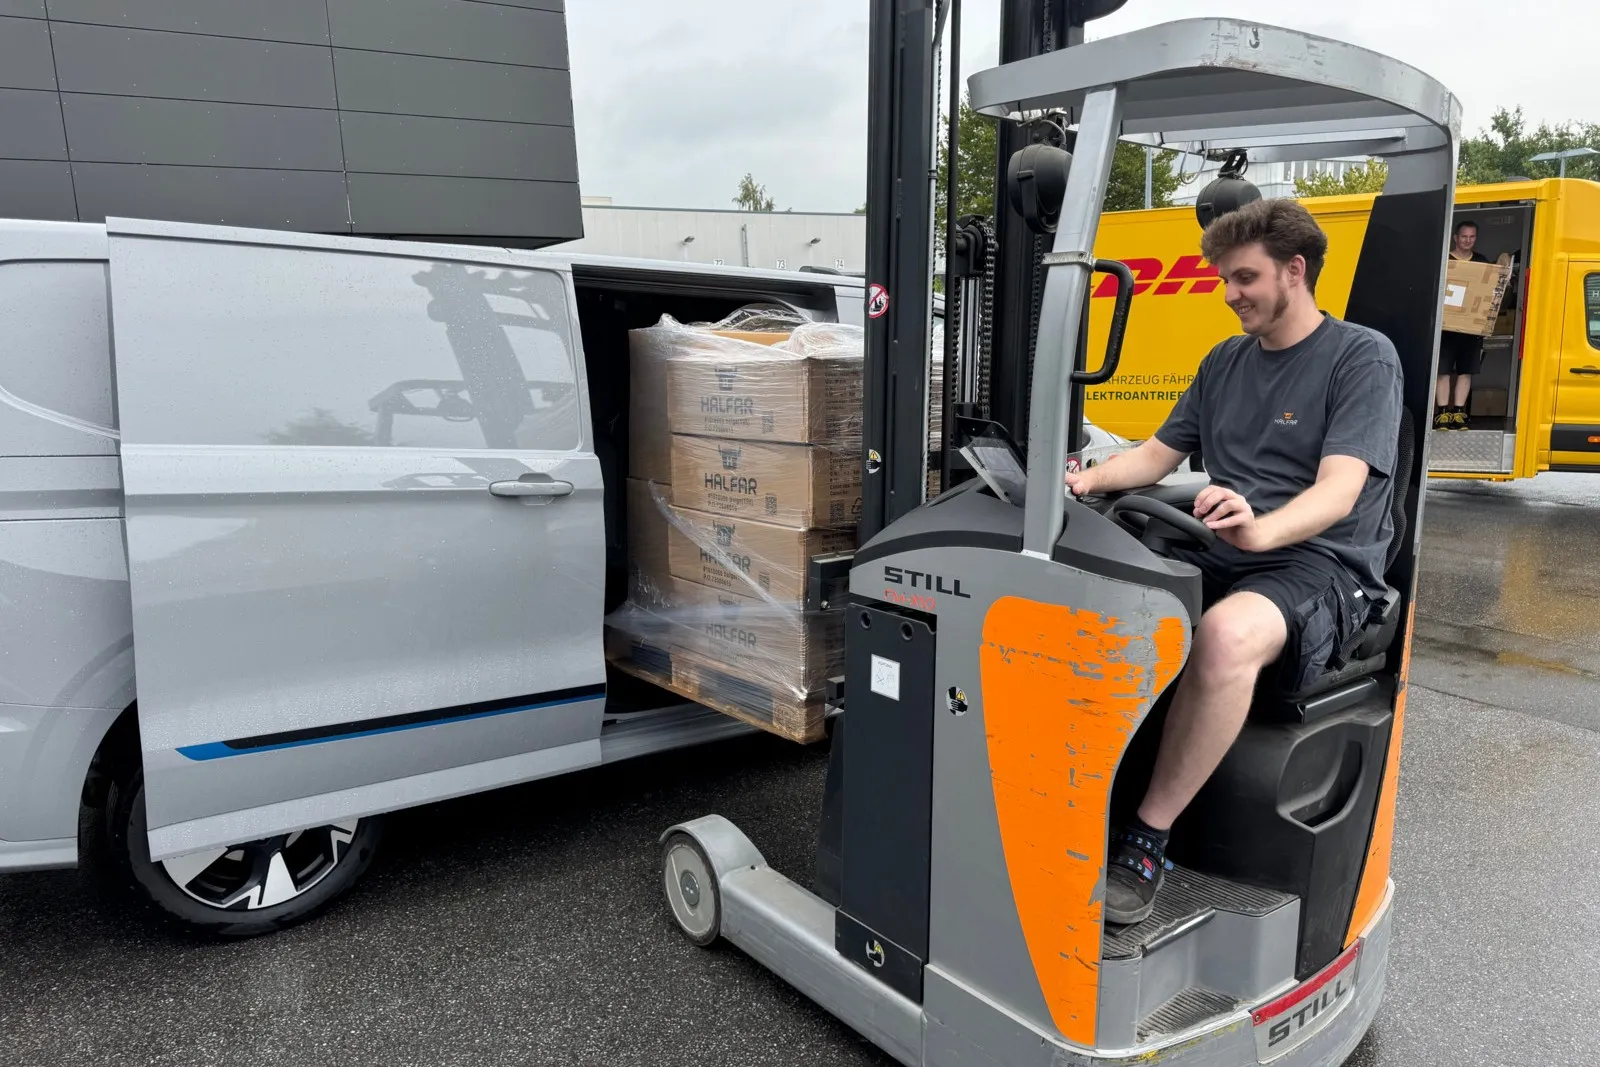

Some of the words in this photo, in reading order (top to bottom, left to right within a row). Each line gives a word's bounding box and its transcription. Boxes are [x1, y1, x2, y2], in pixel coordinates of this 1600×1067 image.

[777, 259, 786, 269] 73
[836, 259, 844, 269] 74
[1091, 255, 1221, 298] DH
[1104, 374, 1160, 385] HRZEUG
[1163, 372, 1197, 385] FÄHR
[700, 396, 754, 415] HALFAR
[1085, 390, 1185, 401] LEKTROANTRIE
[704, 472, 758, 496] HALFAR
[700, 547, 751, 573] HAR
[884, 566, 971, 599] STILL
[706, 623, 757, 648] HALFAR
[1268, 980, 1346, 1047] STILL
